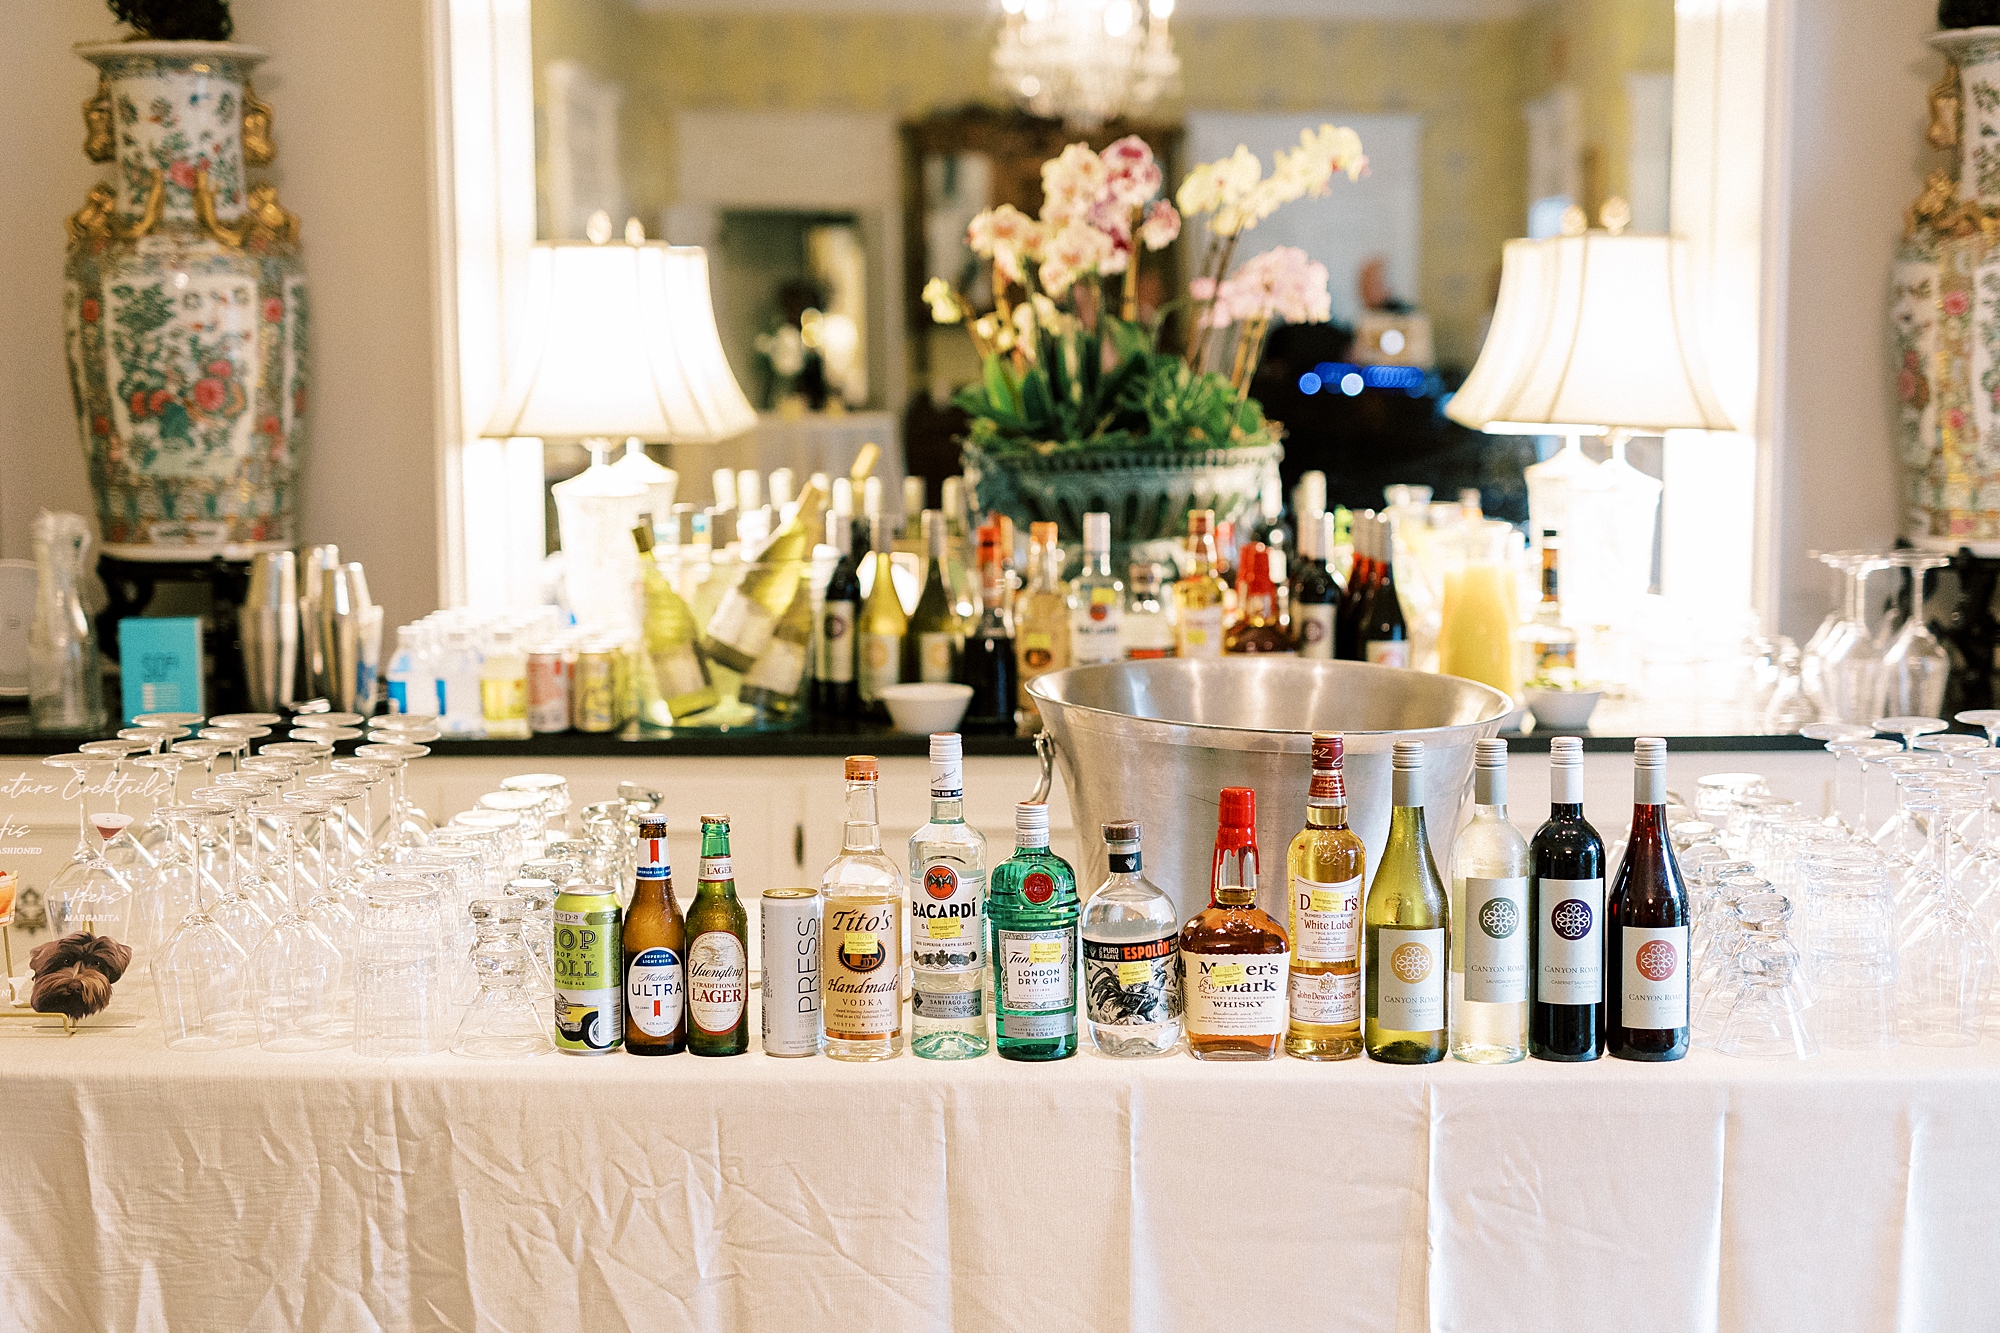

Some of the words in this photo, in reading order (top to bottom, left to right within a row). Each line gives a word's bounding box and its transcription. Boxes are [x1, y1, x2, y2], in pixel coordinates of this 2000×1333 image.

[0, 772, 58, 799] ature
[62, 770, 169, 801] Cocktails
[0, 847, 42, 855] SHIONED
[68, 880, 122, 914] Hers
[1299, 893, 1359, 911] Dr's
[64, 914, 120, 922] MARGARITA
[832, 908, 893, 931] Tito's
[554, 927, 597, 950] OP
[688, 959, 745, 981] Yuengling
[797, 917, 818, 1013] PRESS
[1198, 961, 1279, 975] Mer's
[1471, 964, 1505, 973] CANYON
[1544, 965, 1578, 974] CANYON
[1018, 968, 1060, 977] LONDON
[696, 981, 738, 989] TRADITIONAL
[827, 973, 899, 995] Handmade
[1042, 976, 1060, 985] GIN
[1219, 978, 1277, 992] Mark
[631, 981, 683, 997] ULTRA
[692, 987, 742, 1004] LAGER
[842, 998, 883, 1006] VODKA
[1384, 995, 1418, 1004] CANYON
[1628, 994, 1662, 1002] CANYON
